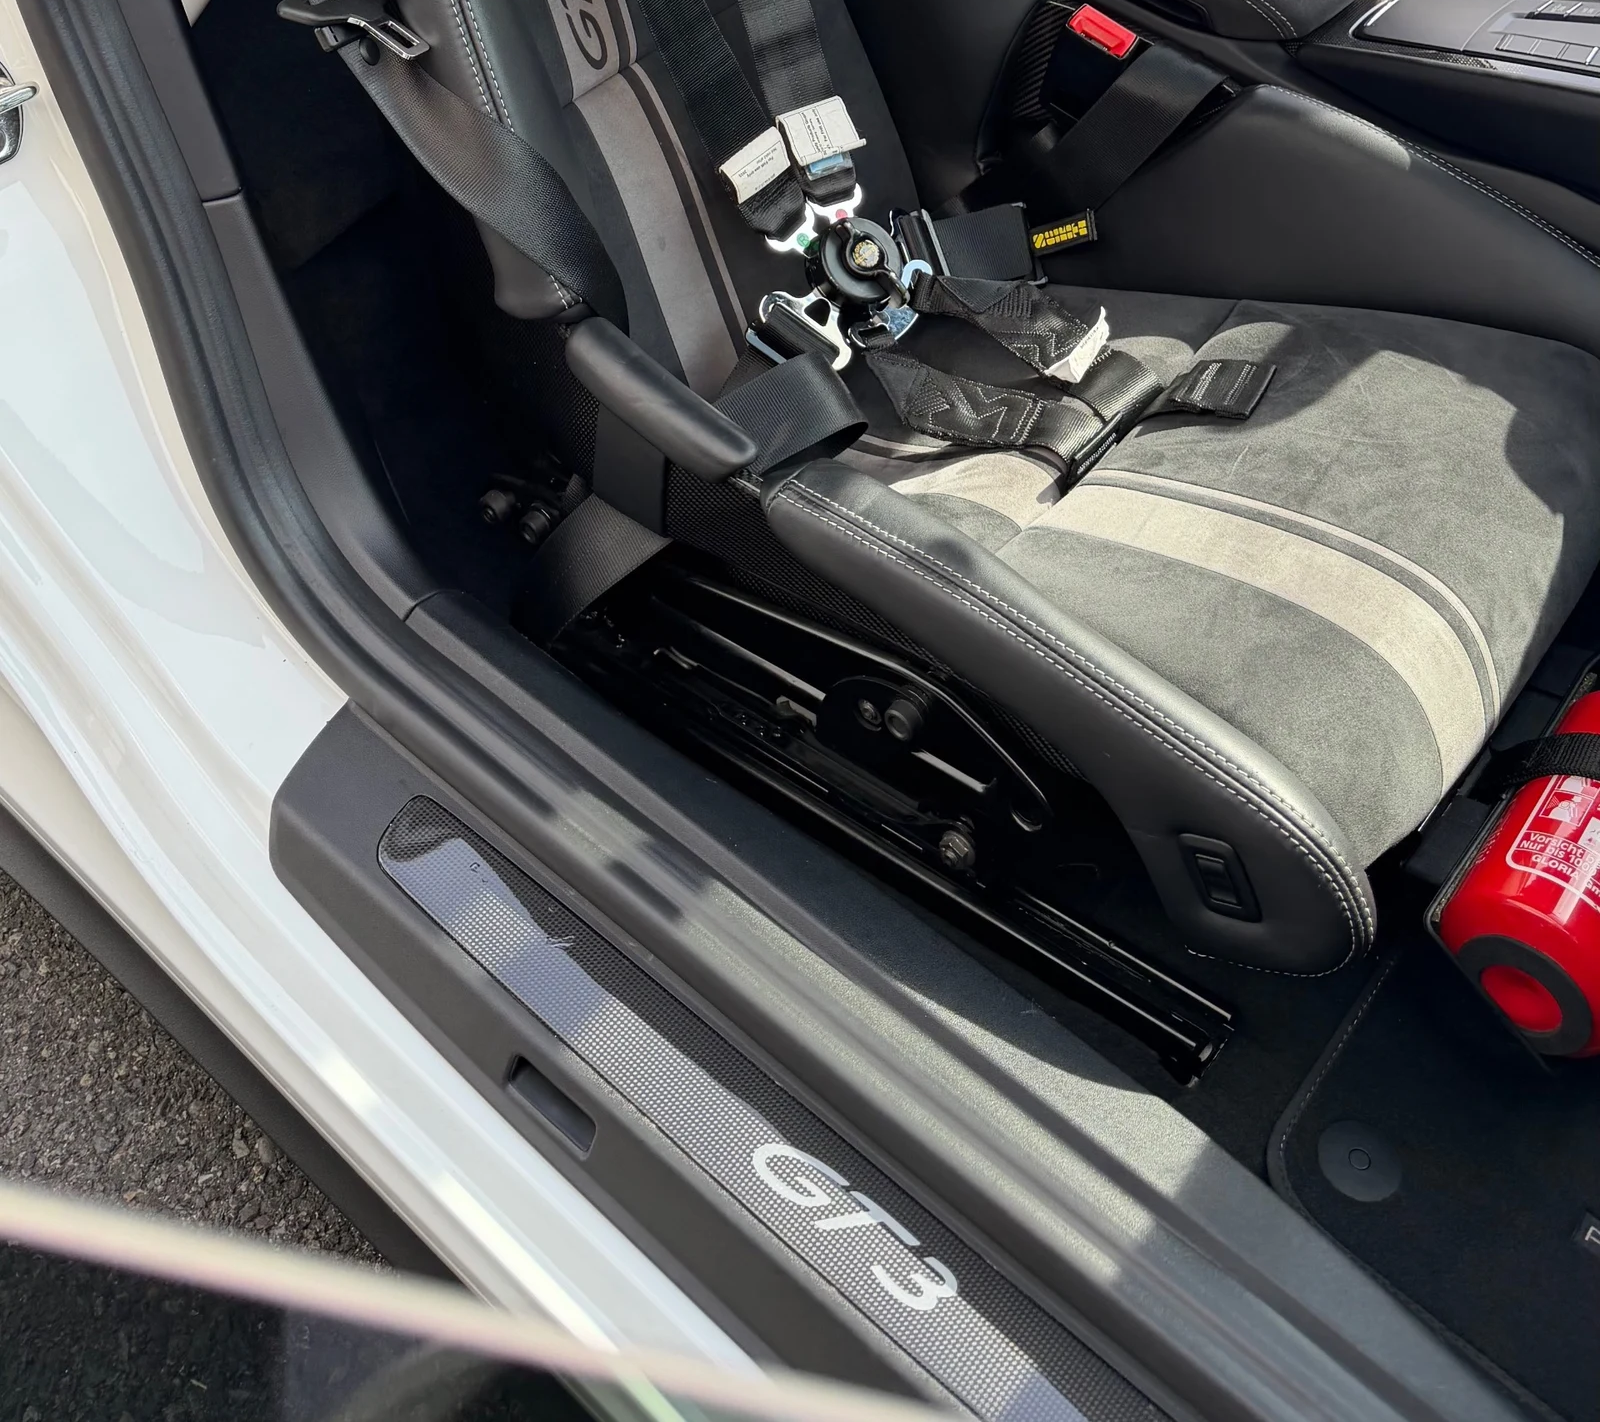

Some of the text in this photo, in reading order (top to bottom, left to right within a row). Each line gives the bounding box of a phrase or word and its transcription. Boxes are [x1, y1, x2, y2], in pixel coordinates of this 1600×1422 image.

[1520, 840, 1545, 851] Nur
[1546, 845, 1565, 858] bis
[1530, 832, 1584, 858] Vorsicht
[1532, 854, 1579, 880] GLORIA
[752, 1143, 958, 1310] GT3
